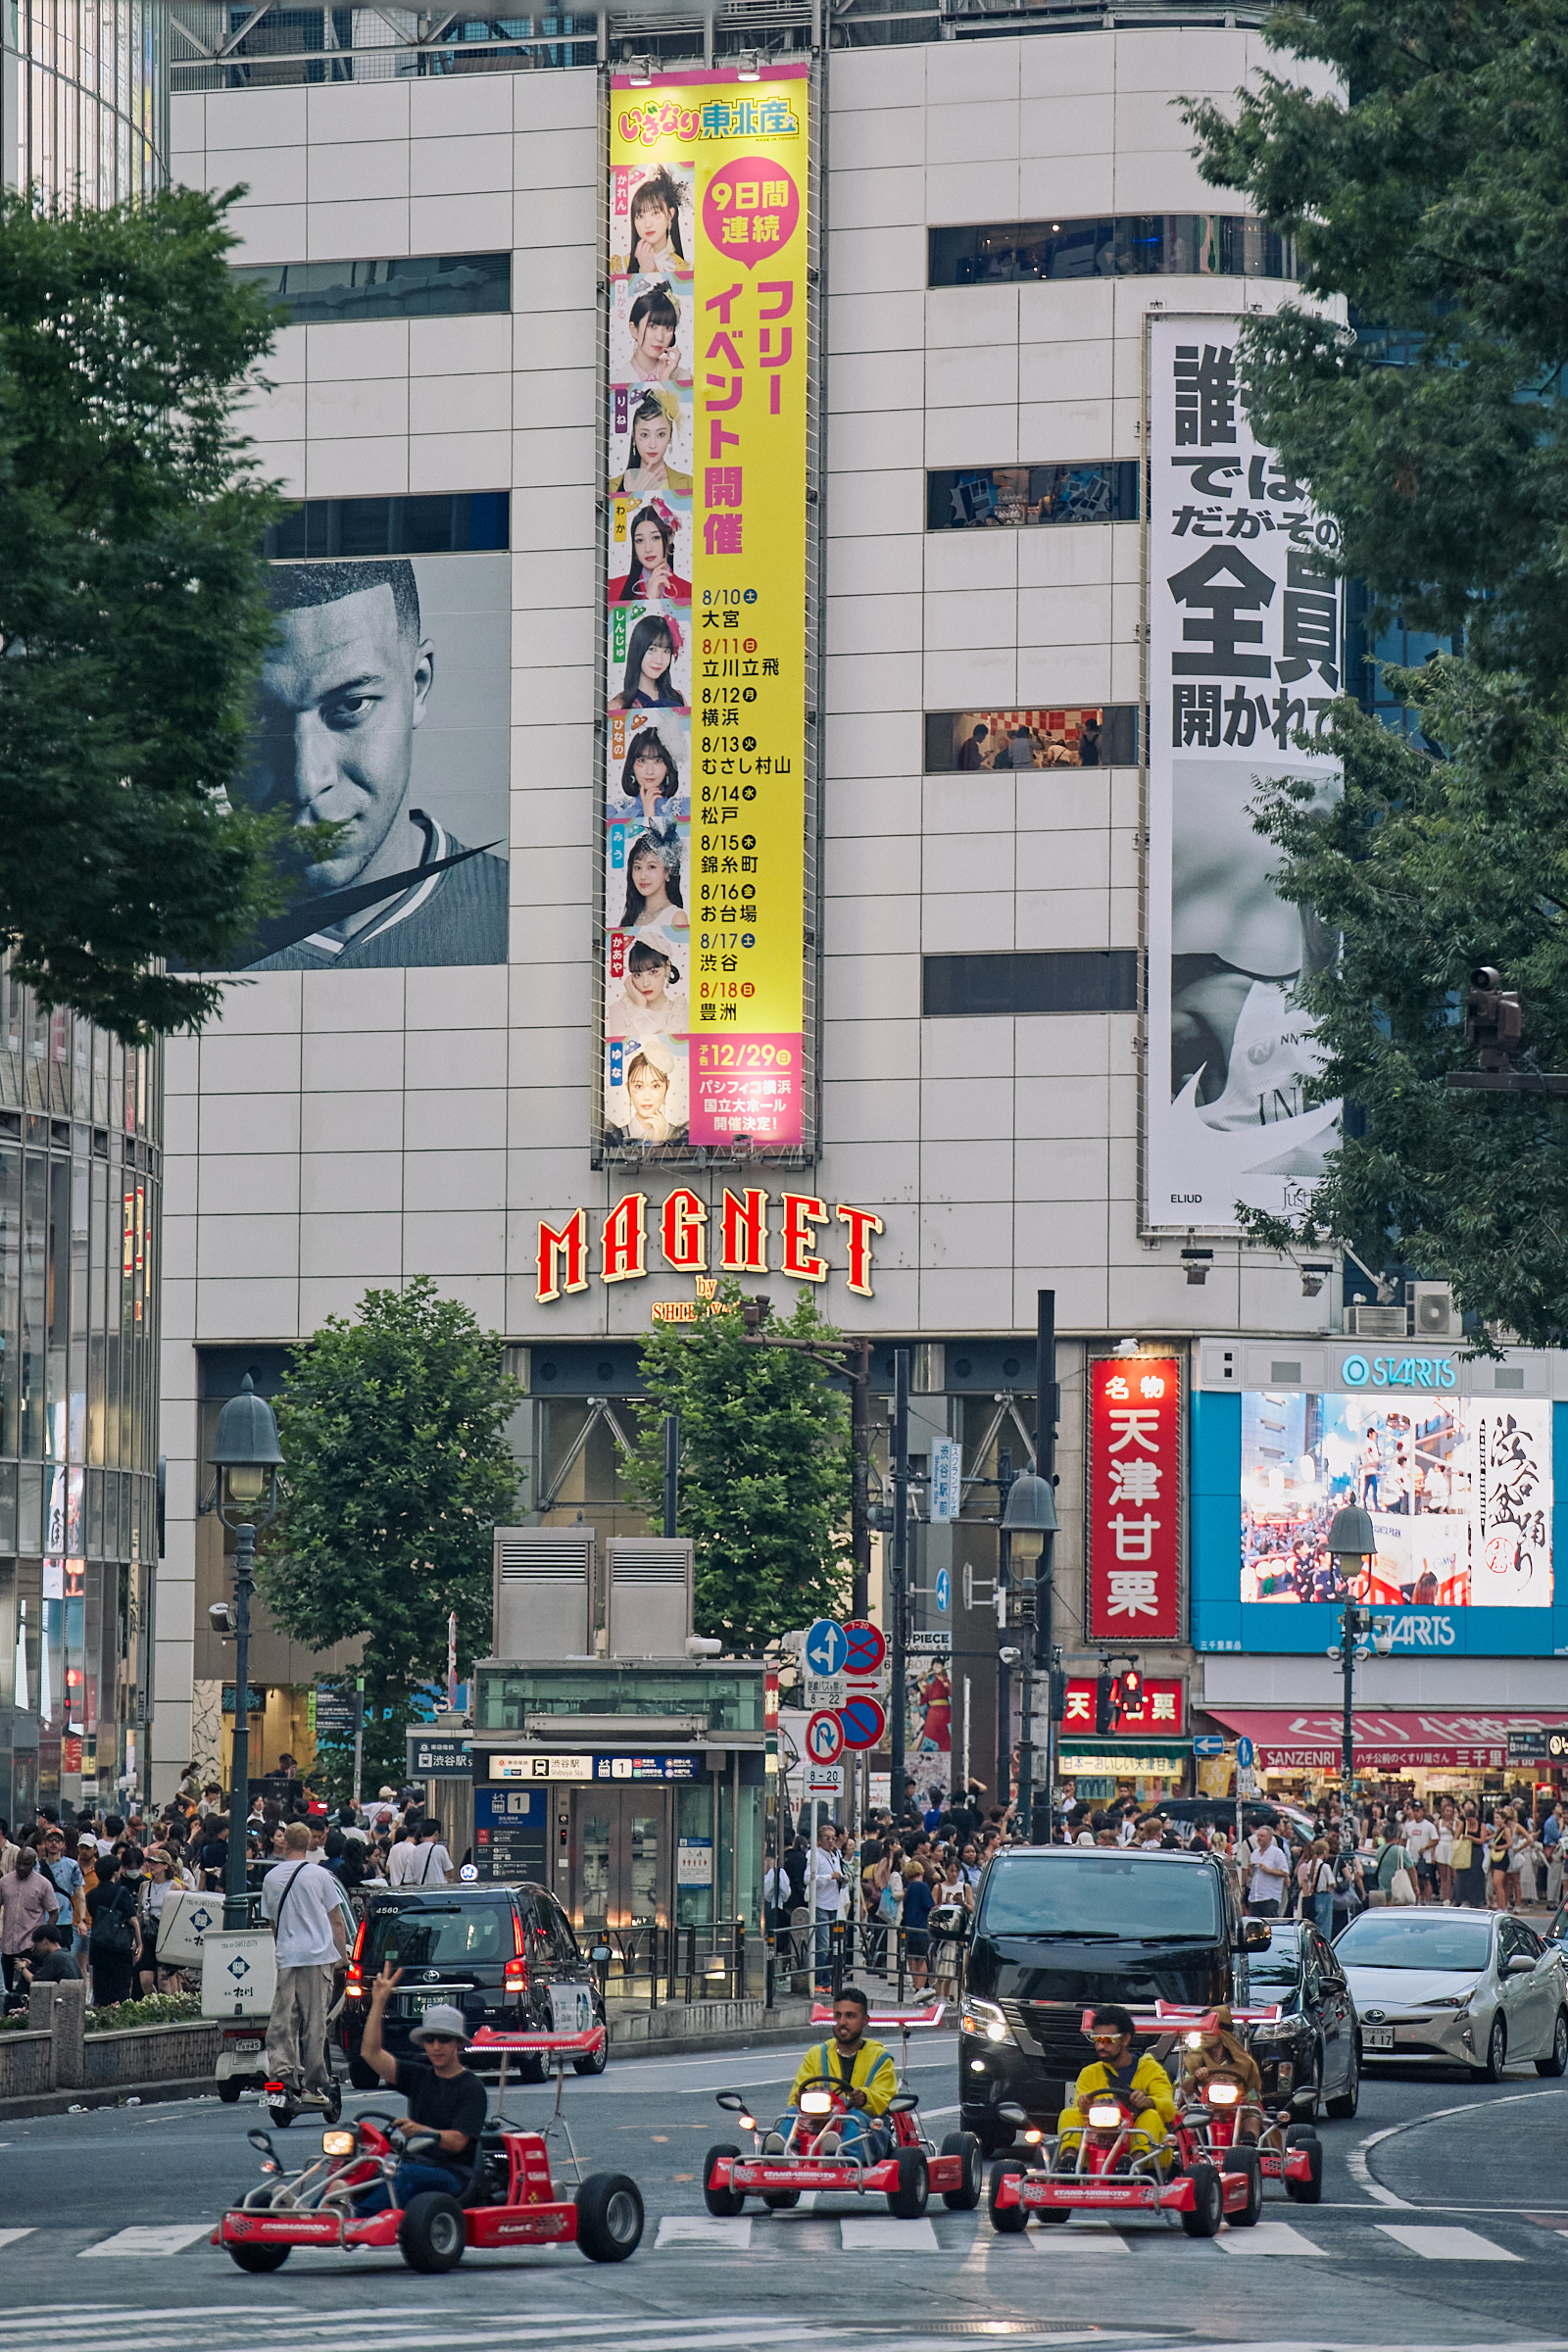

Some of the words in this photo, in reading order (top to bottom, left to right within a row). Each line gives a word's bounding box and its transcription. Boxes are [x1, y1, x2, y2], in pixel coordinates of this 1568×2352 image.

[615, 173, 628, 212] かれん
[710, 179, 789, 211] 9日間
[721, 215, 780, 244] 連続
[615, 282, 627, 320] ひかる
[758, 280, 794, 415] フリー
[615, 395, 627, 426] りね
[703, 282, 745, 555] イベント開催
[615, 504, 627, 535] わか
[1171, 505, 1343, 549] だがその
[702, 610, 740, 629] 大宮
[1166, 544, 1341, 692] 全員
[614, 608, 626, 659] しんじゅ
[702, 658, 780, 677] 立川立飛
[702, 708, 739, 727] 横浜
[613, 718, 624, 756] ひなの
[702, 756, 791, 775] むさし村山
[701, 807, 739, 825] 松戸
[612, 831, 623, 860] みう
[701, 856, 759, 874] 錦糸町
[701, 905, 758, 923] お台場
[612, 937, 623, 973] かあや
[700, 954, 738, 972] 渋谷
[700, 1003, 737, 1021] 豊洲
[612, 1049, 623, 1079] ゆな
[699, 1044, 709, 1066] 予告
[700, 1079, 792, 1095] パシフィコ横浜
[704, 1098, 787, 1113] 国立大ホール
[713, 1116, 778, 1132] 開催決定!
[1170, 1194, 1202, 1203] ELIUD
[1282, 1187, 1307, 1211] Just
[535, 1187, 884, 1304] MAGNET
[695, 1275, 717, 1299] by
[1371, 1356, 1456, 1389] STARTS
[1105, 1375, 1164, 1400] 名物
[1106, 1408, 1163, 1618] 天津甘栗
[912, 1634, 950, 1643] PIECE
[432, 1754, 467, 1767] 渋谷駅
[551, 1758, 580, 1769] 渋谷駅
[1267, 1750, 1336, 1766] SANZENRI
[1356, 1751, 1450, 1764] ハチ公前のくすり屋さん
[514, 1796, 521, 1810] 1
